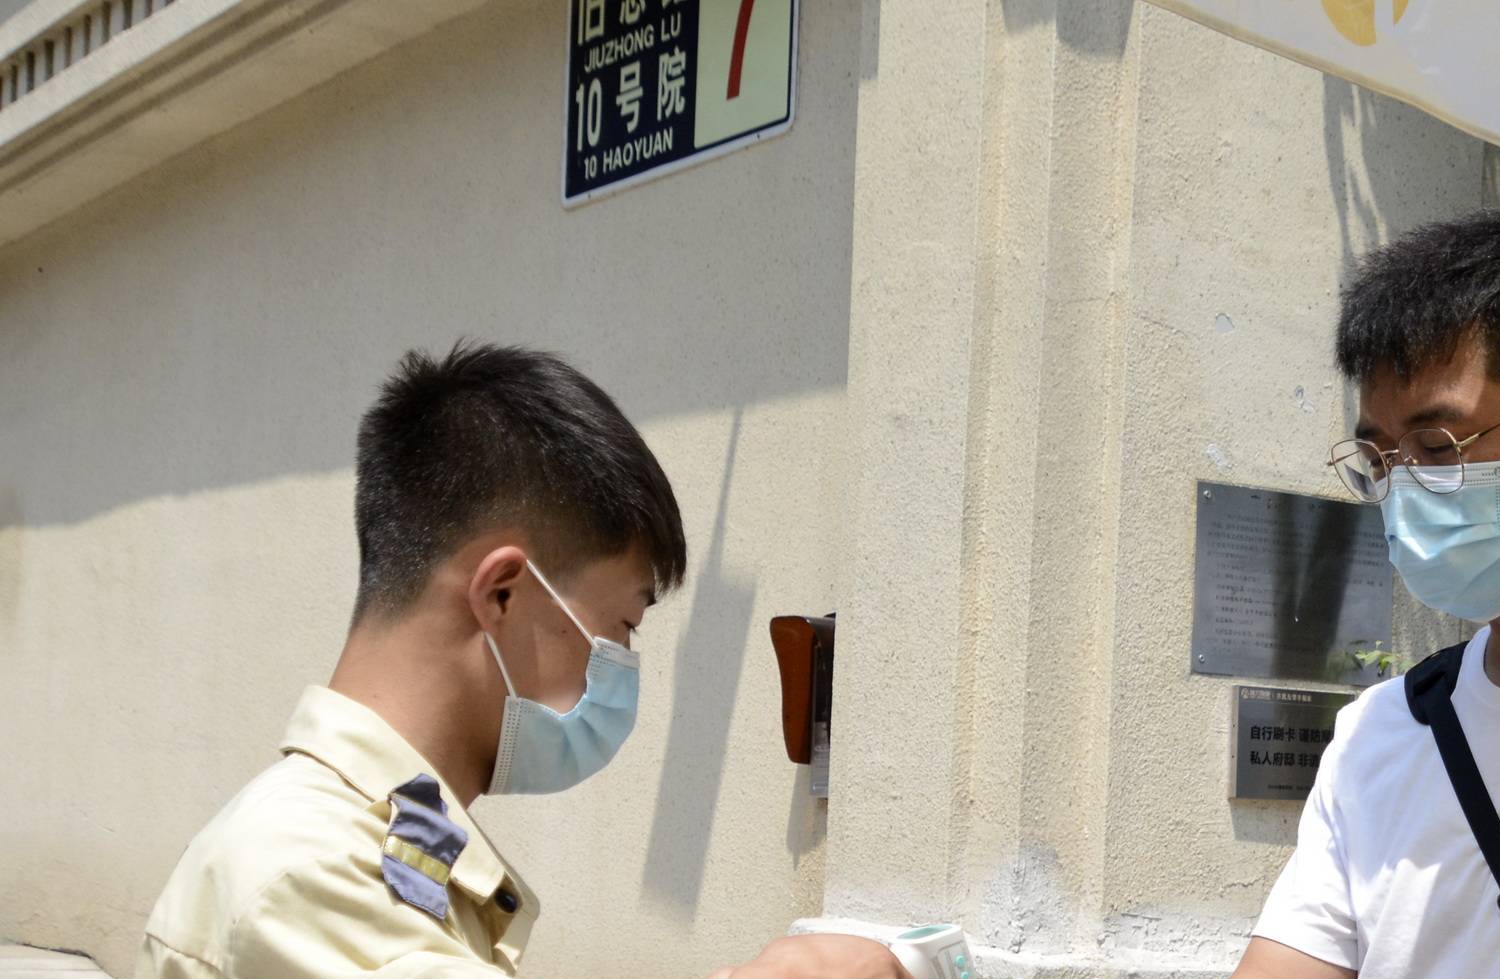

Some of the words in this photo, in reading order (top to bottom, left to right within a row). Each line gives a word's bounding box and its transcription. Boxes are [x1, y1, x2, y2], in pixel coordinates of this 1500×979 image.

[584, 24, 655, 74] JIUZHONG
[660, 12, 682, 43] LU
[575, 46, 687, 152] 10号院
[584, 157, 598, 181] 10
[602, 127, 674, 174] HAOYUAN
